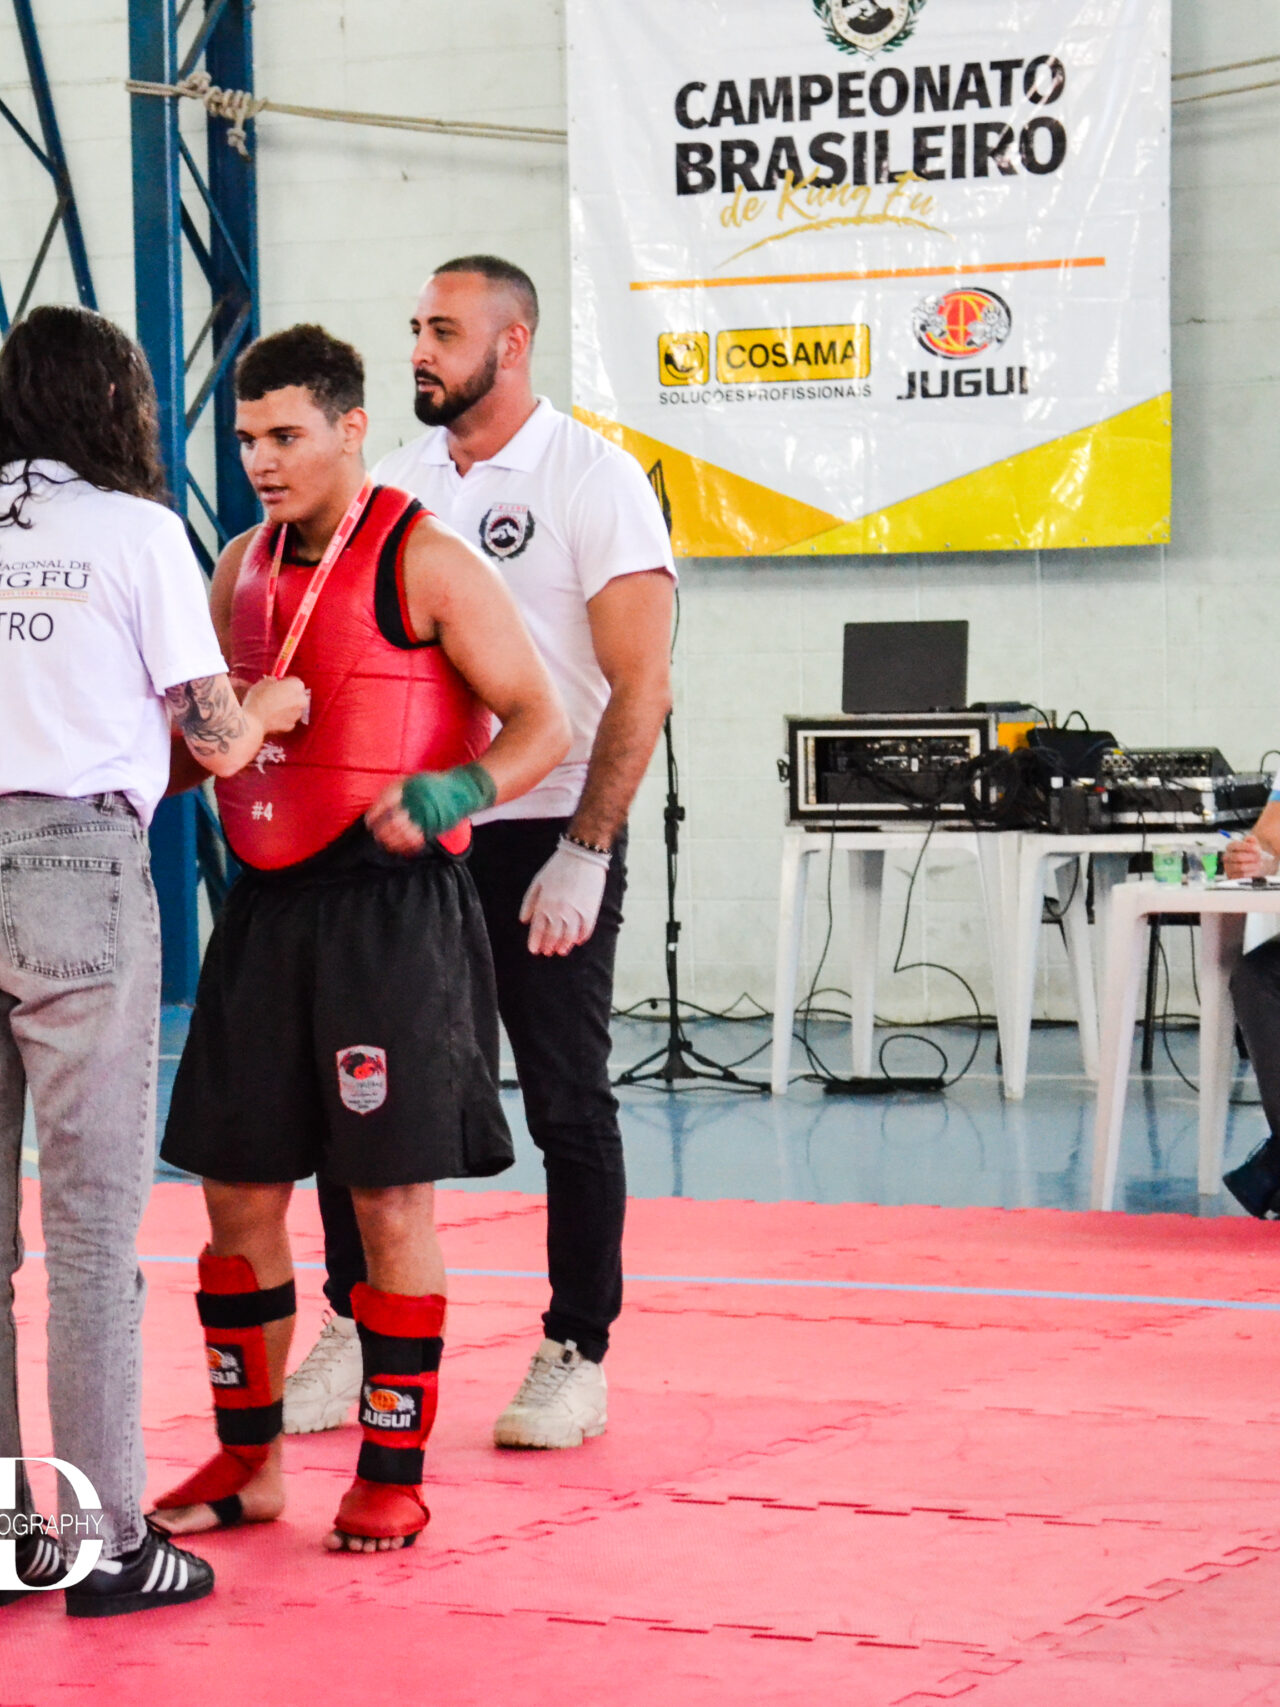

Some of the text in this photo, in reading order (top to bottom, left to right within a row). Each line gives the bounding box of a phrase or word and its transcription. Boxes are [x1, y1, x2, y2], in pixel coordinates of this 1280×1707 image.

[674, 54, 1067, 130] CAMPEONATO
[675, 116, 1068, 196] BRASILEIRO
[719, 166, 936, 228] de Kung Fu
[725, 340, 857, 370] COSAMA
[896, 366, 1029, 400] JUGUI
[40, 570, 90, 590] FU
[69, 561, 92, 571] DE
[251, 801, 273, 821] #4
[362, 1408, 412, 1428] JUGUI
